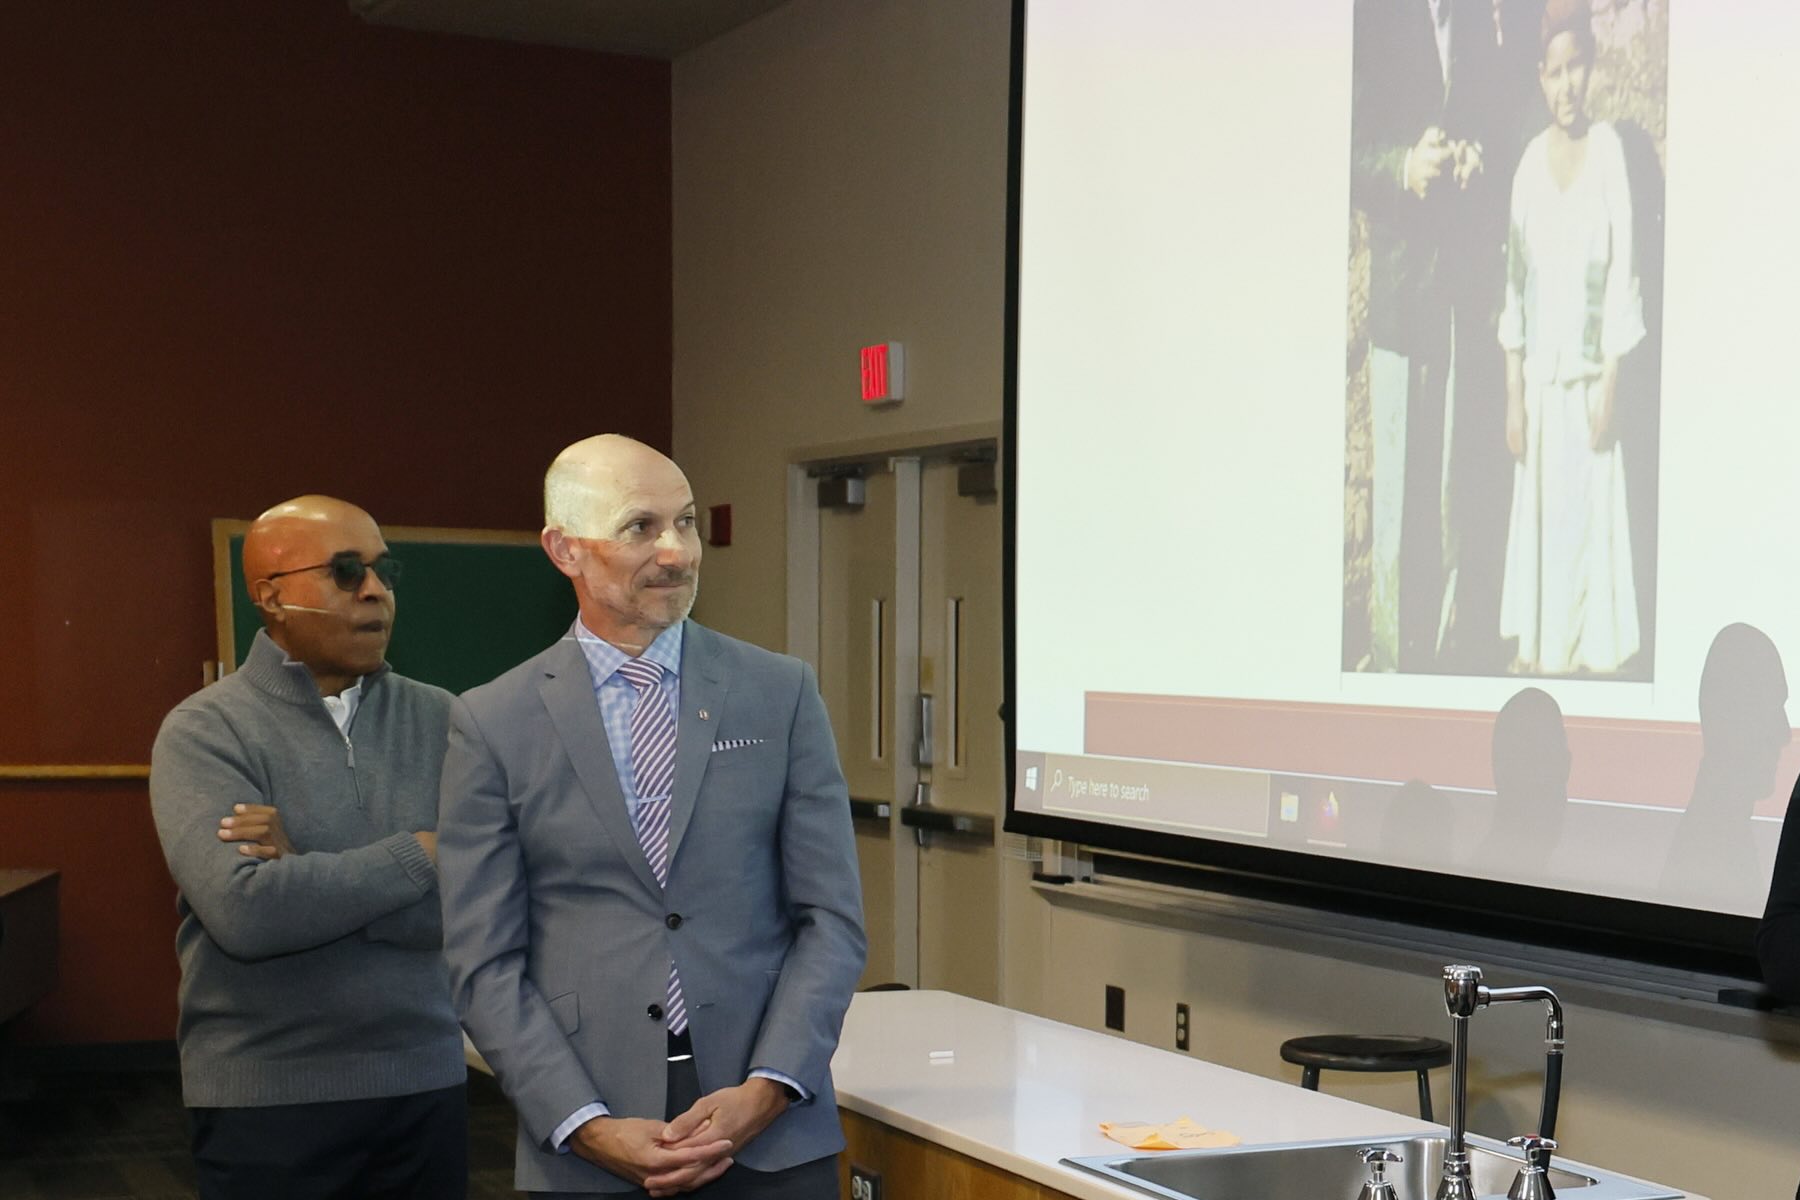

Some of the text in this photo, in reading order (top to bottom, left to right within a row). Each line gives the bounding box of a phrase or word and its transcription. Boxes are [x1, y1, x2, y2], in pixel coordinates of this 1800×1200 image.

[861, 345, 887, 400] EXIT
[1068, 776, 1150, 801] Type here to search
